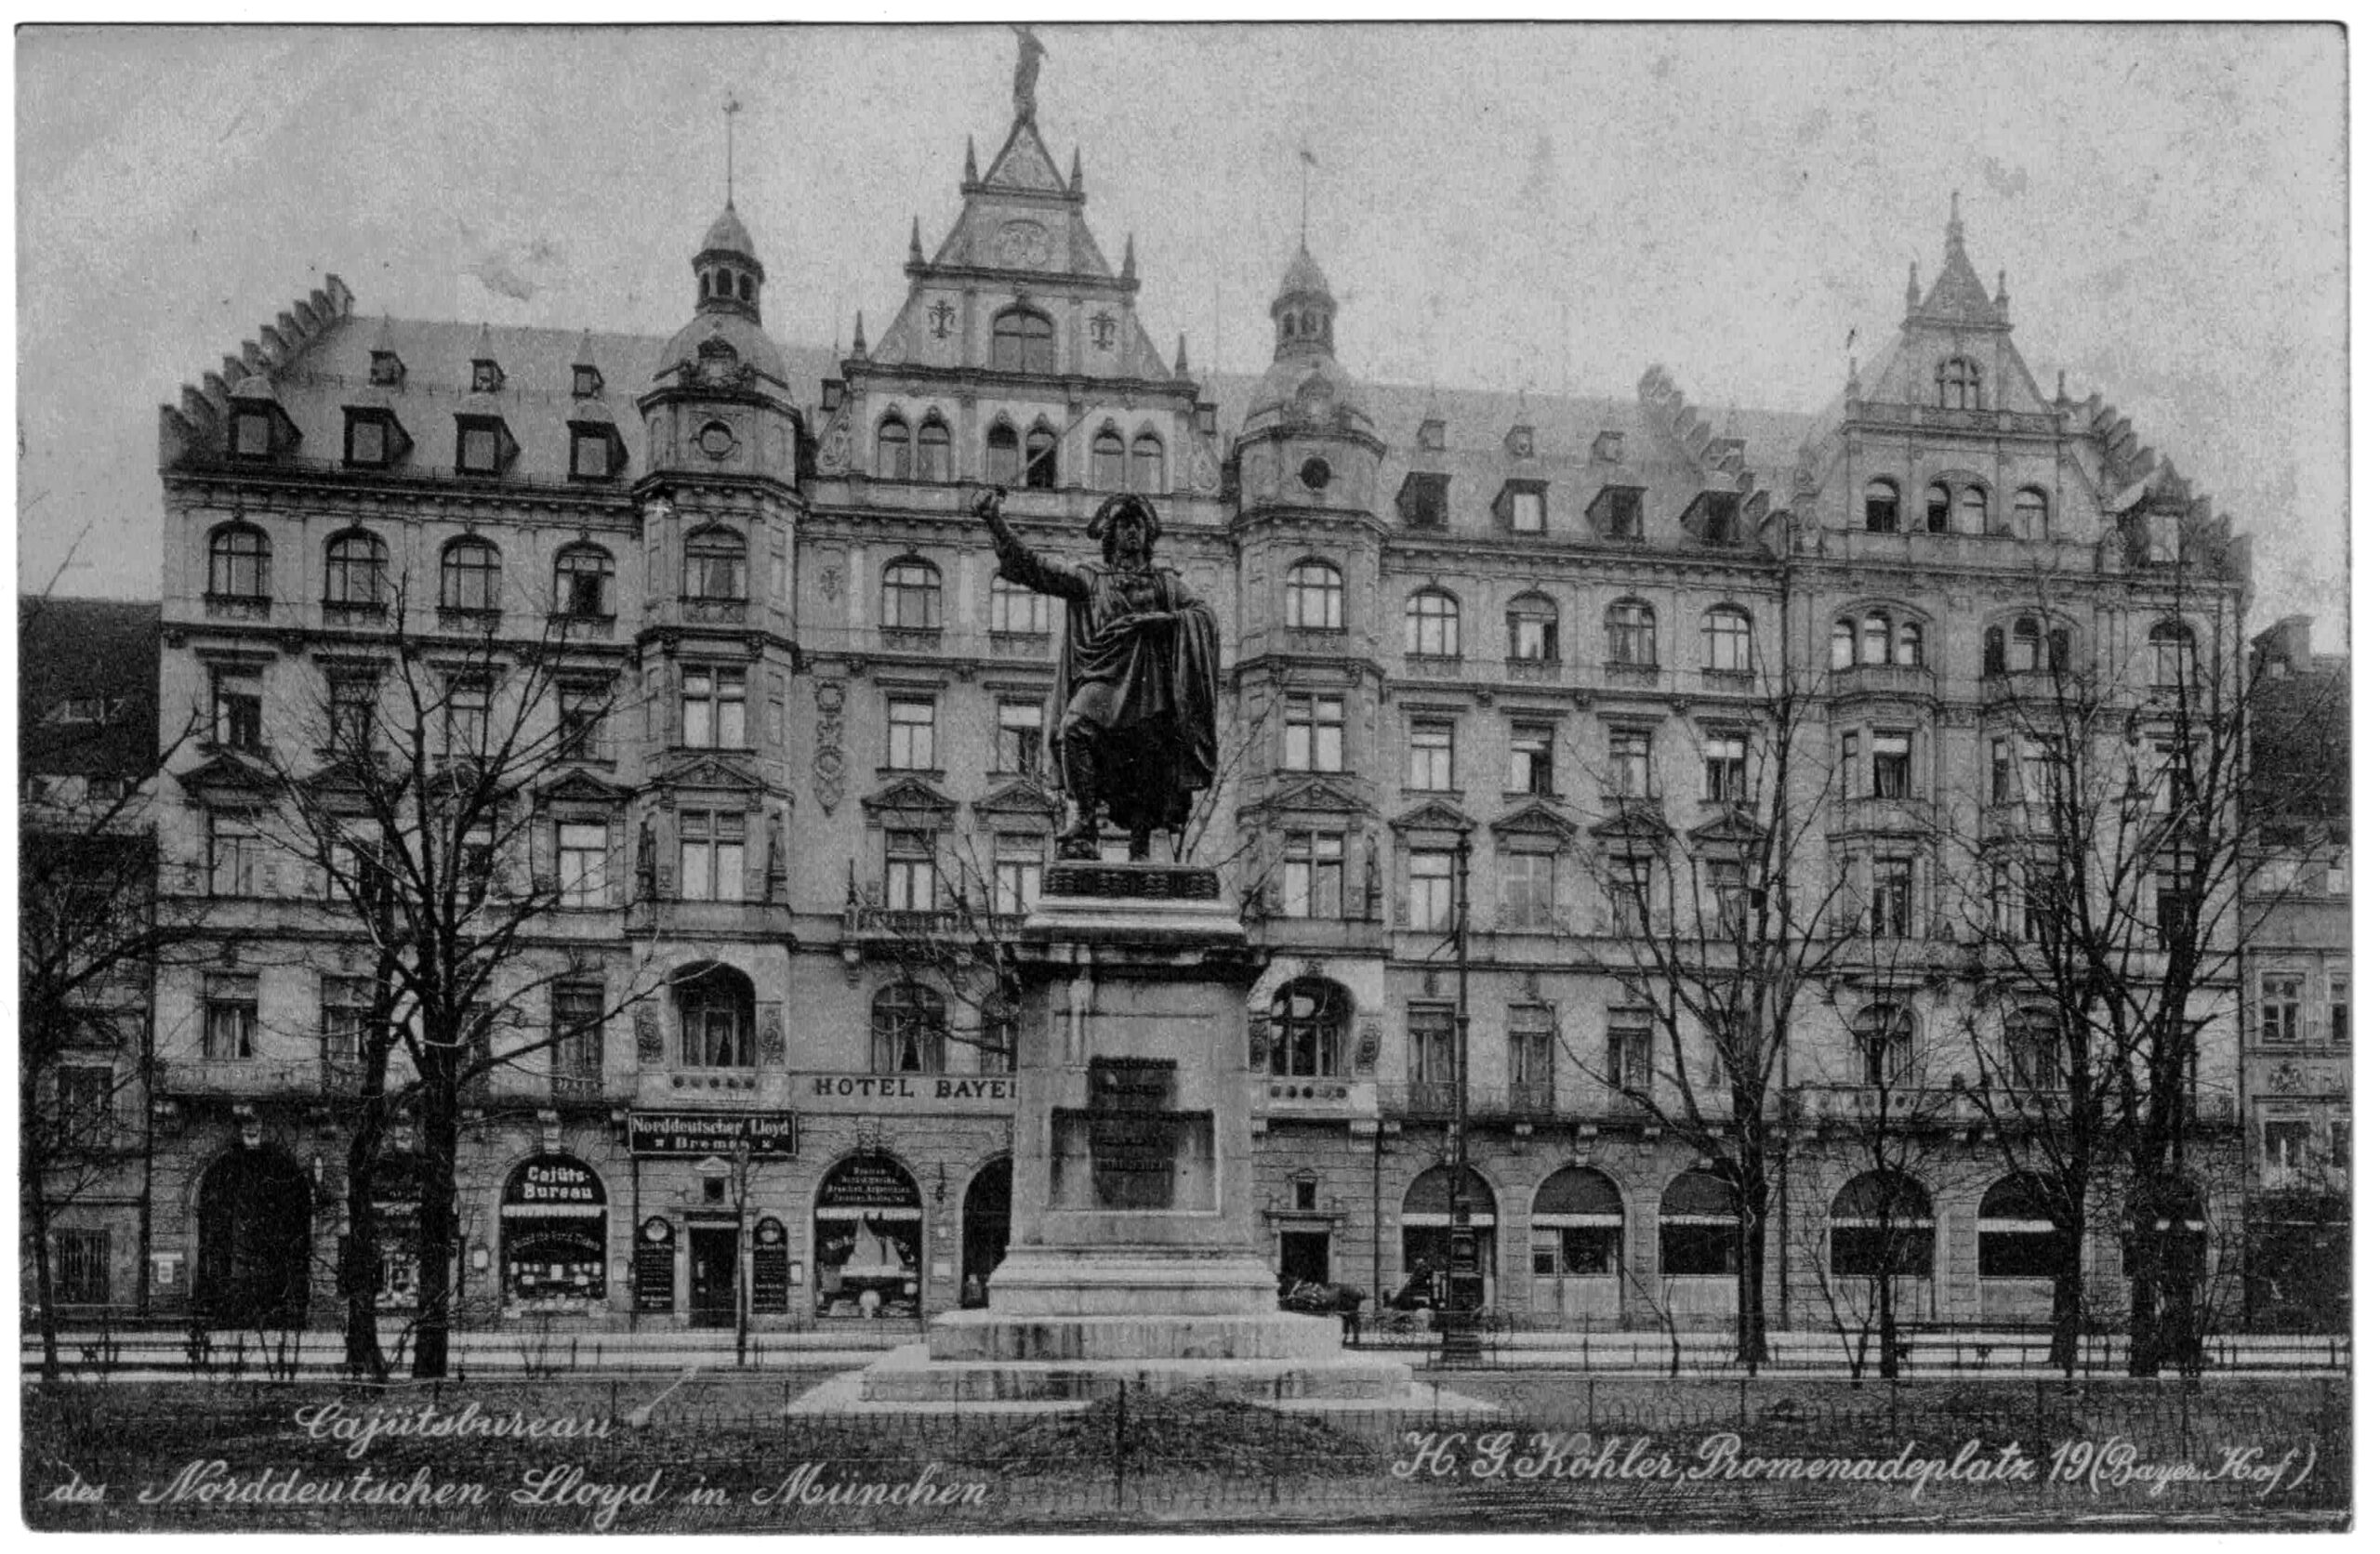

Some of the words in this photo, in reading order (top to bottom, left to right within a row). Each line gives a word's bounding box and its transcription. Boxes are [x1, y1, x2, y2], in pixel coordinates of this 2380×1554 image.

[814, 1077, 914, 1098] HOTEL
[632, 1117, 744, 1135] Norddeutscher
[751, 1118, 789, 1137] Lloyd
[675, 1136, 751, 1151] Bremen
[527, 1166, 590, 1182] Cajüts-
[523, 1182, 593, 1199] Bureau
